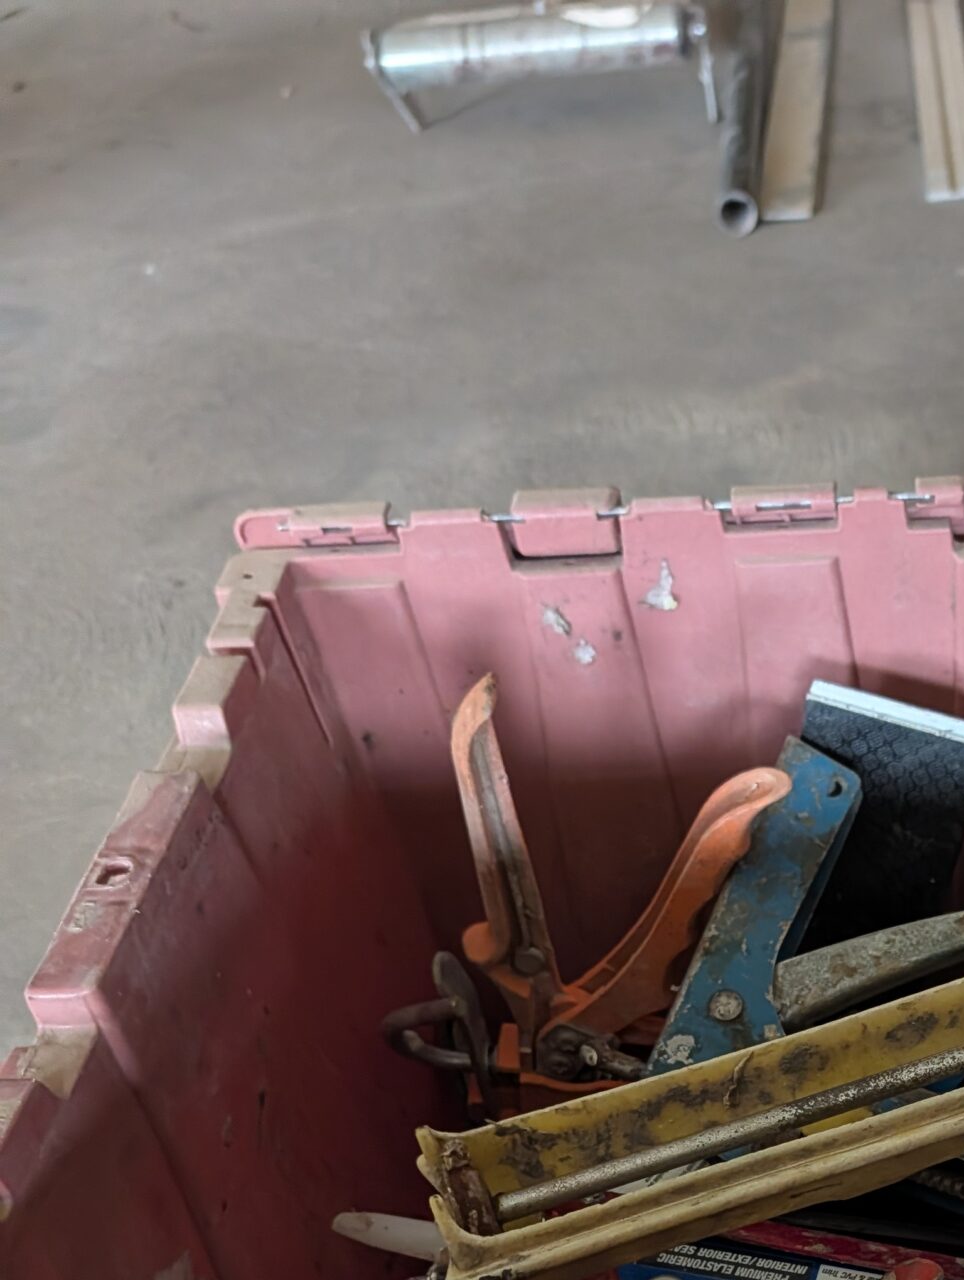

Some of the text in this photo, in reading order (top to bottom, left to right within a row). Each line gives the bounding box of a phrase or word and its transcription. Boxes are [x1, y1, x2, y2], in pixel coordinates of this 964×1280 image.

[656, 1252, 733, 1275] ELASTOMERIC
[821, 1268, 839, 1279] Trim
[840, 1271, 858, 1280] PVC
